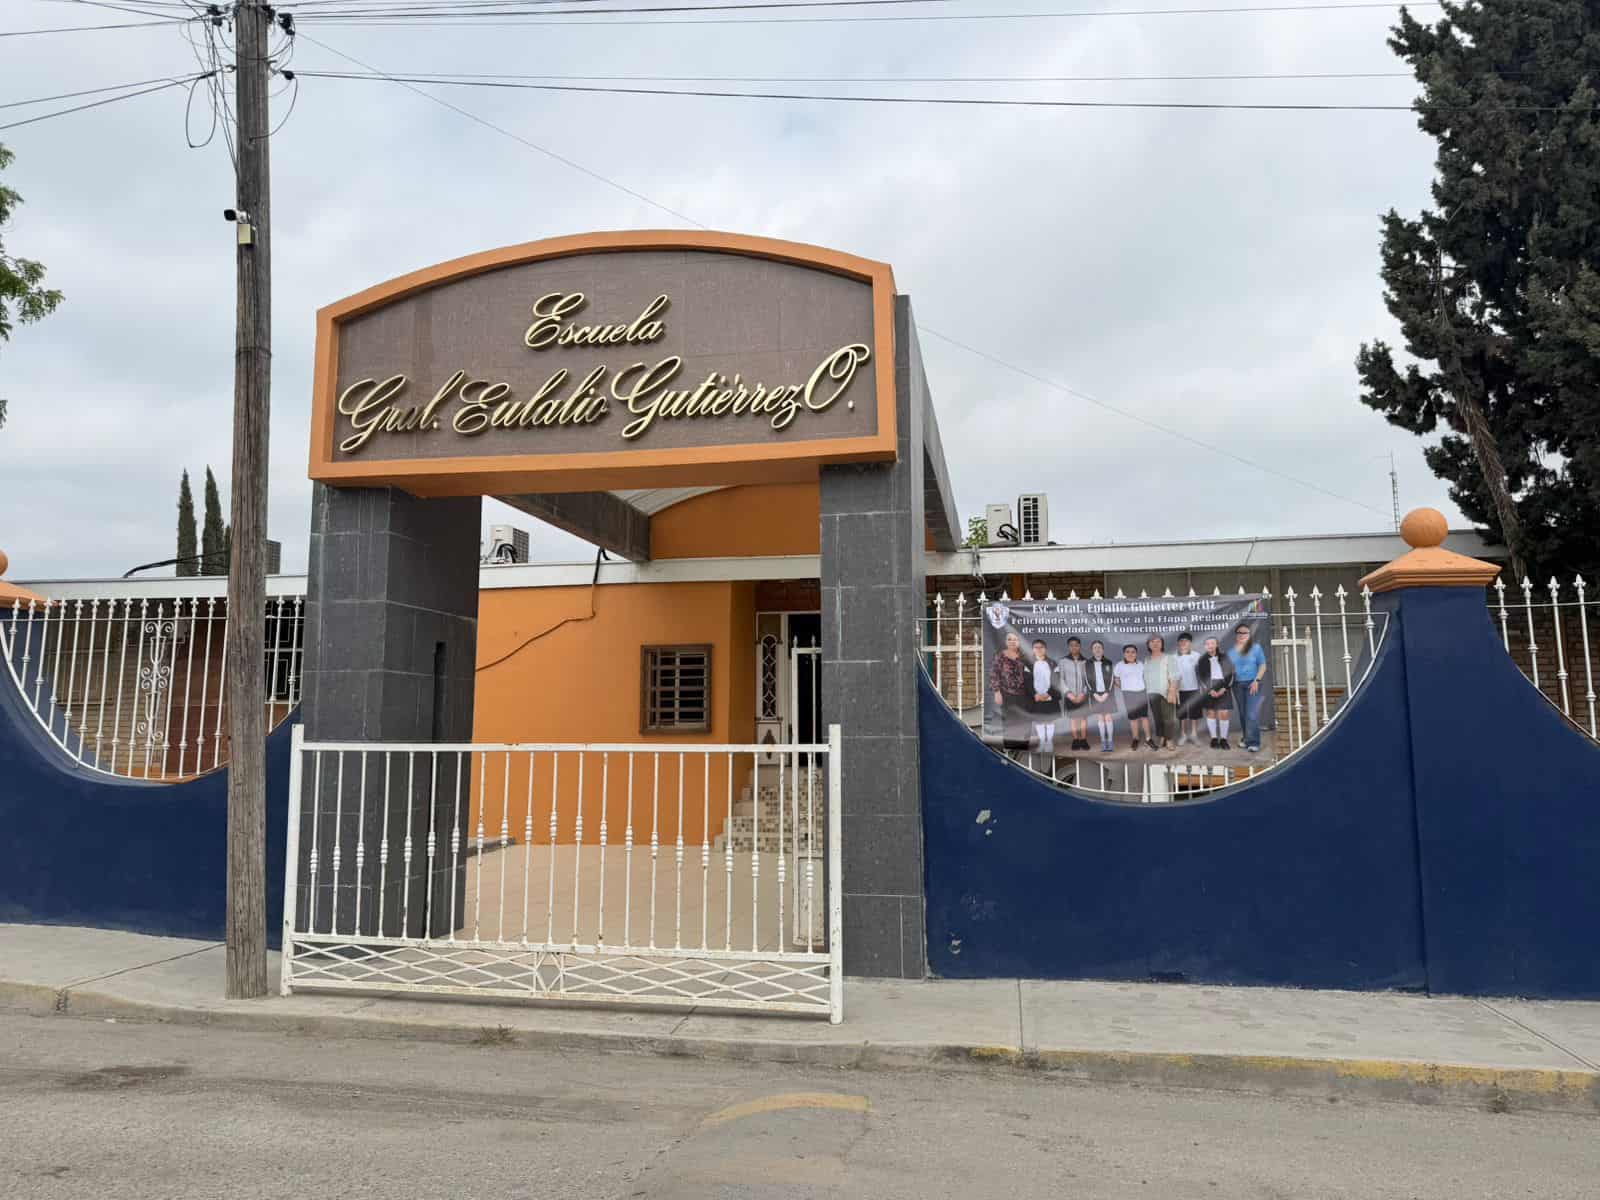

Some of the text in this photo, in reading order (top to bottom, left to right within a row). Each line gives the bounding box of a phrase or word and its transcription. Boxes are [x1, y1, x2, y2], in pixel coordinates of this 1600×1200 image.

[525, 293, 667, 347] Escuela
[338, 370, 464, 451] Gral.
[453, 365, 607, 433] Eulalio
[804, 344, 870, 409] O.
